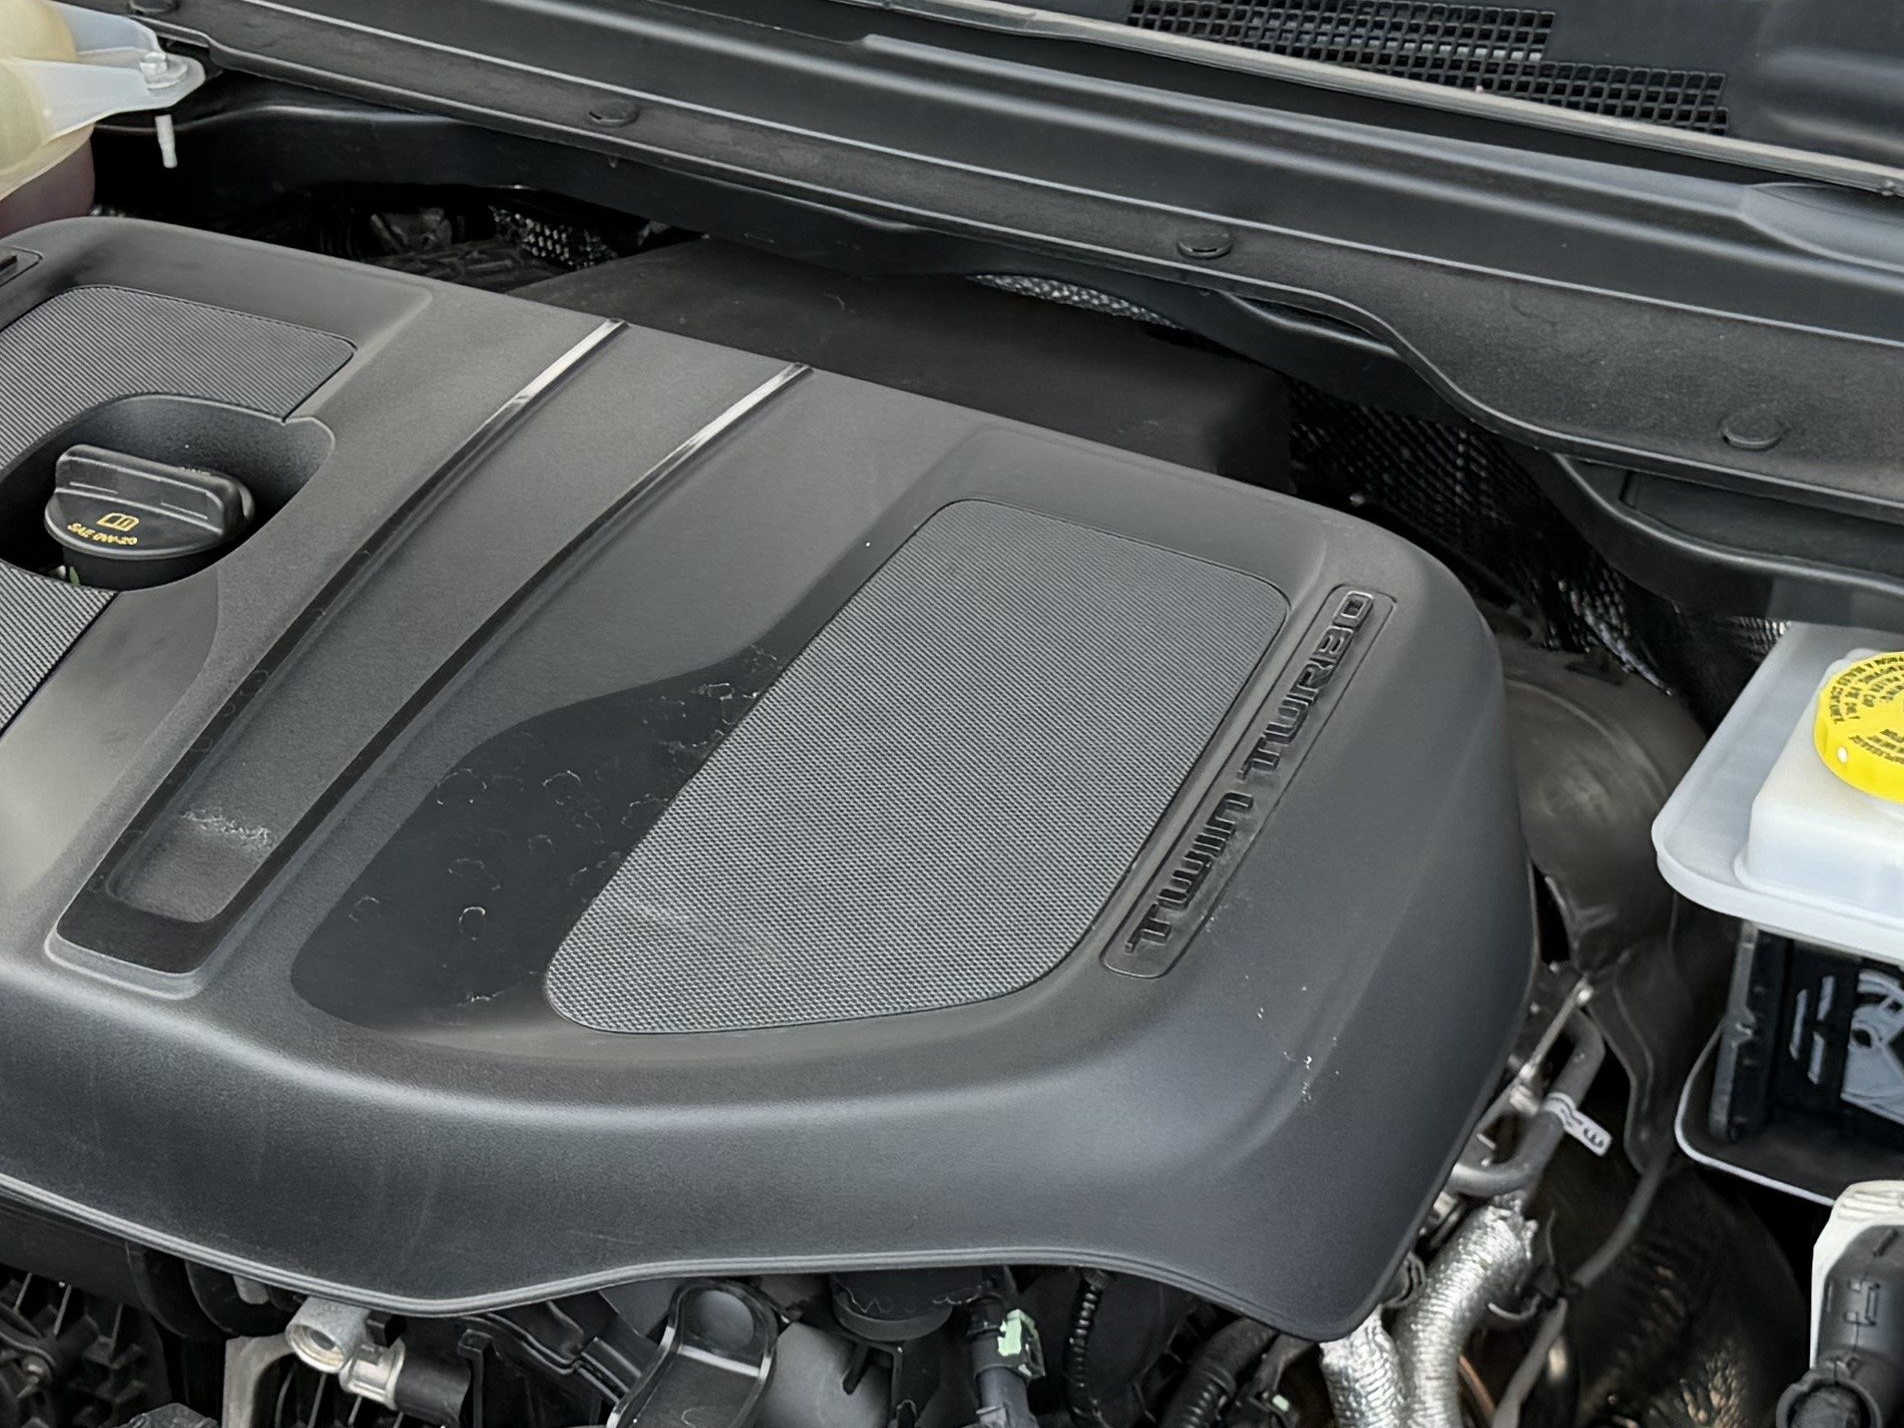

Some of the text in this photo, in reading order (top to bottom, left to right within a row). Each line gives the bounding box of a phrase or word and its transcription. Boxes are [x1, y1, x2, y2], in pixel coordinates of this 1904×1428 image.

[67, 522, 138, 546] SAE 0W-20
[1124, 590, 1375, 953] TWIN TURBO
